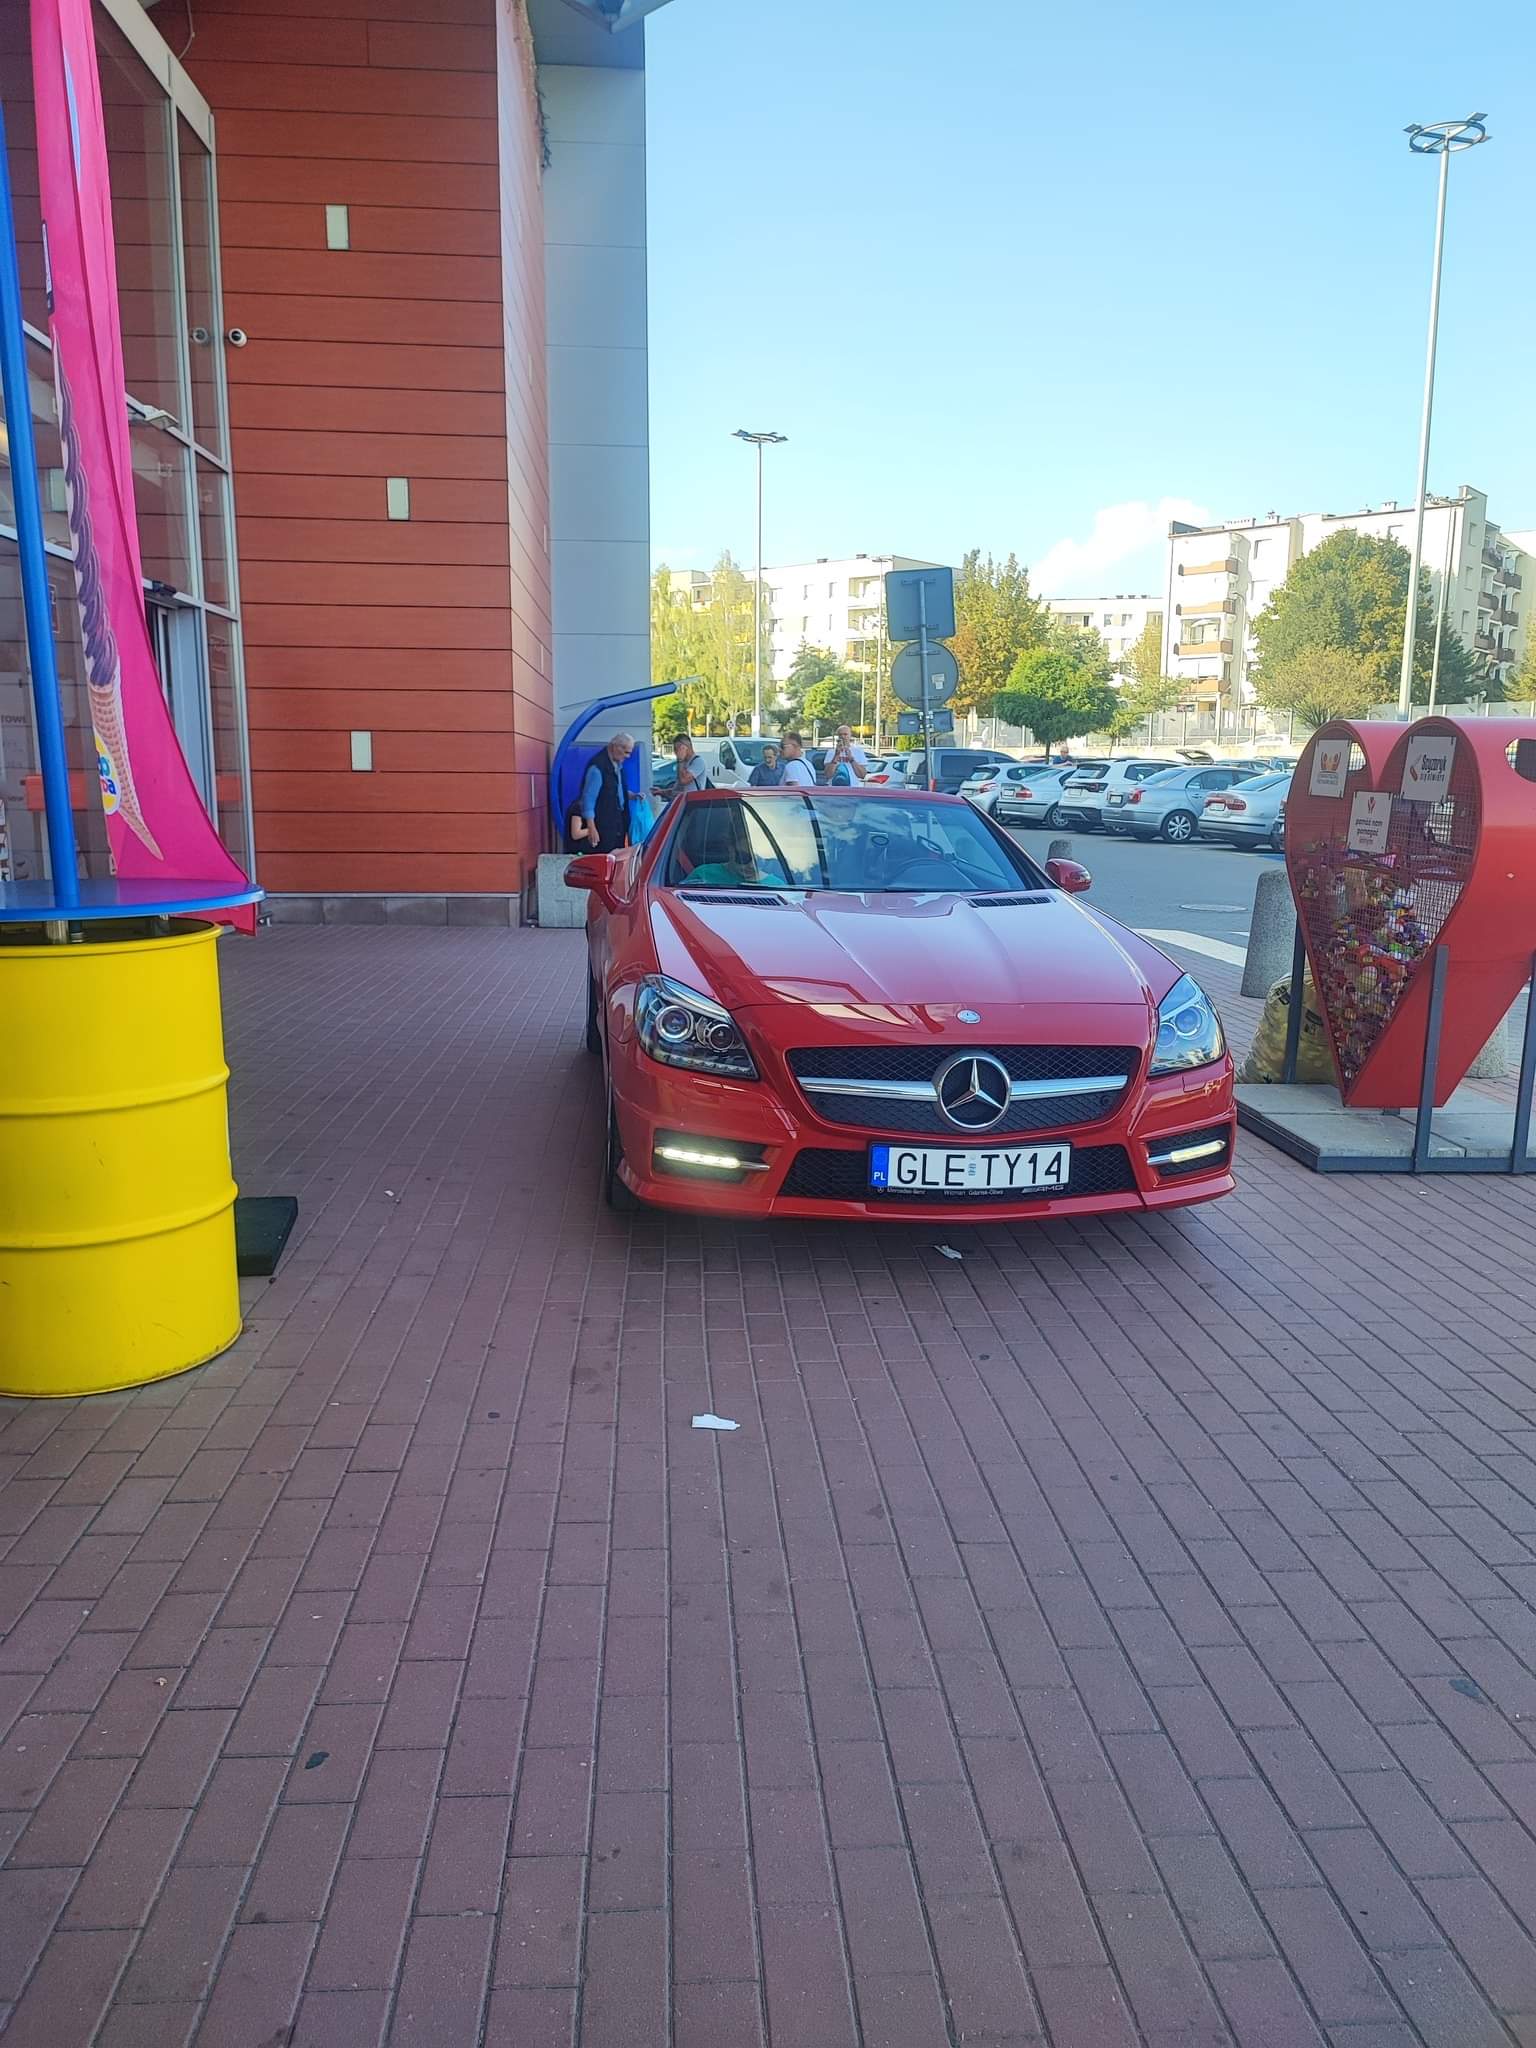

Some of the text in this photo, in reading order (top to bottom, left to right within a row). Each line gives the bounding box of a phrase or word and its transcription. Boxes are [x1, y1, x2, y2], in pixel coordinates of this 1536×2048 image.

[873, 1171, 887, 1181] PL
[897, 1151, 1062, 1186] GLE TY14
